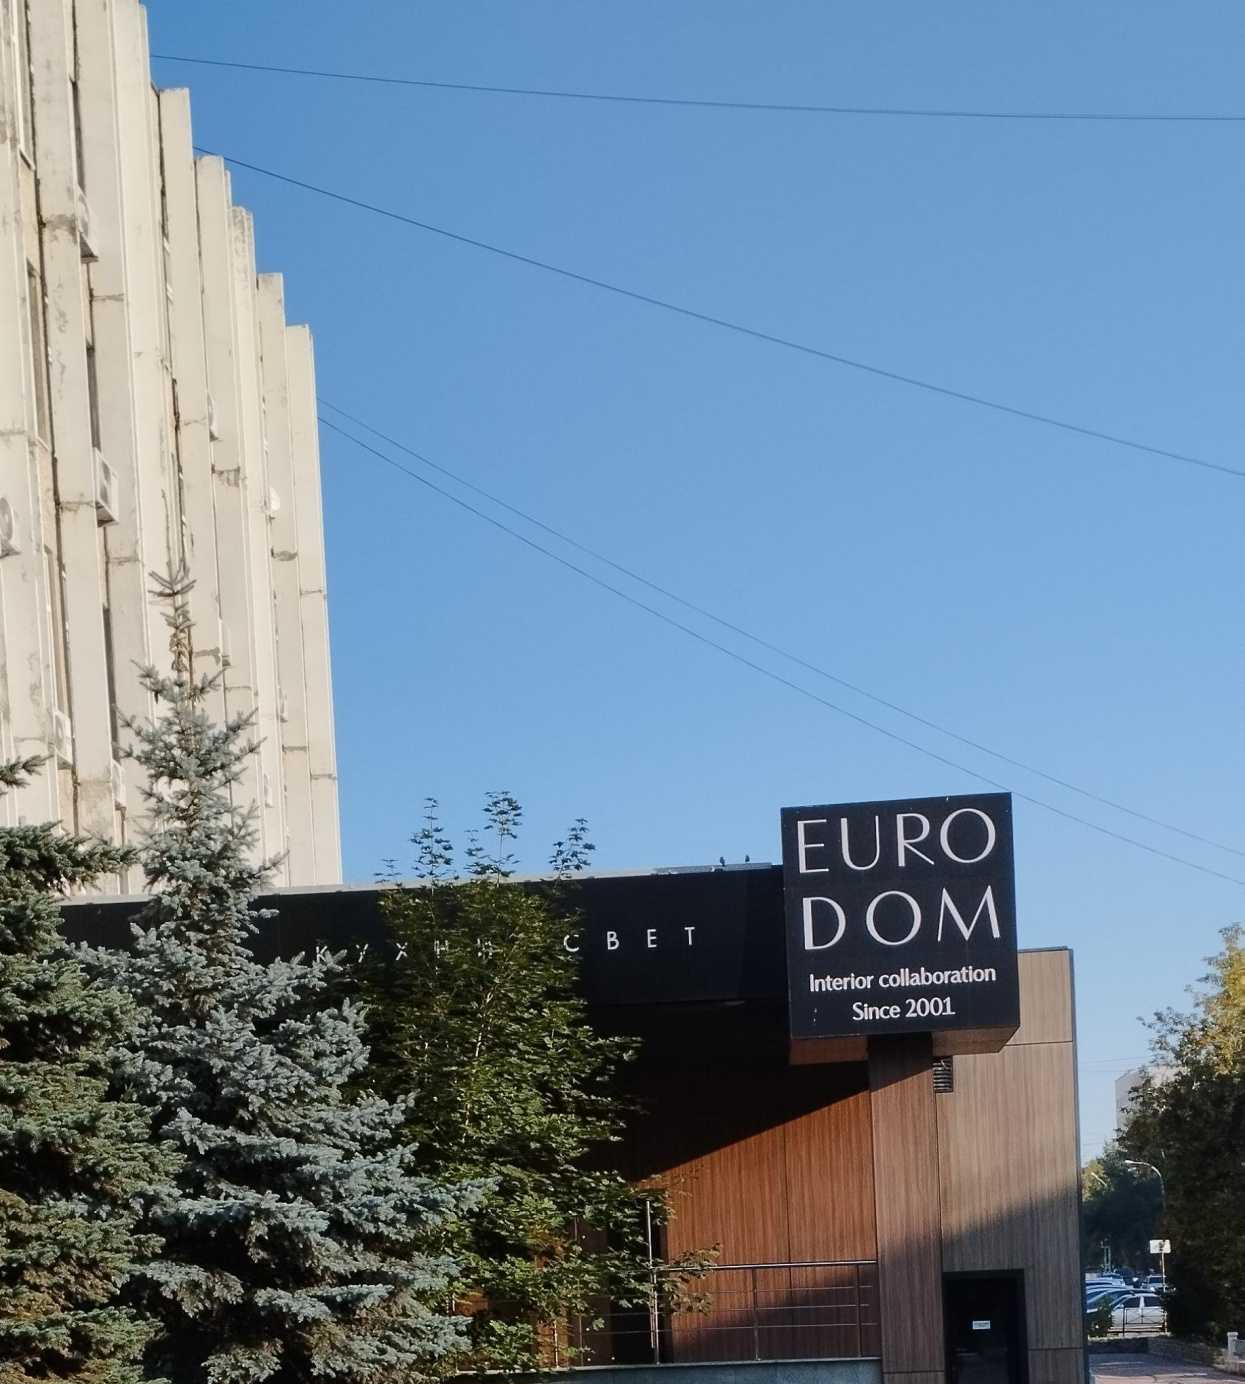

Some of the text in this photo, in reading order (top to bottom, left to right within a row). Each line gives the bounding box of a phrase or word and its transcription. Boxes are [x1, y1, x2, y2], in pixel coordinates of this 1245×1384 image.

[797, 808, 996, 873] EURO
[802, 885, 1001, 950] DOM
[563, 926, 696, 952] СВЕТ
[809, 966, 996, 992] Interior collaboration
[852, 996, 956, 1021] Since 2001
